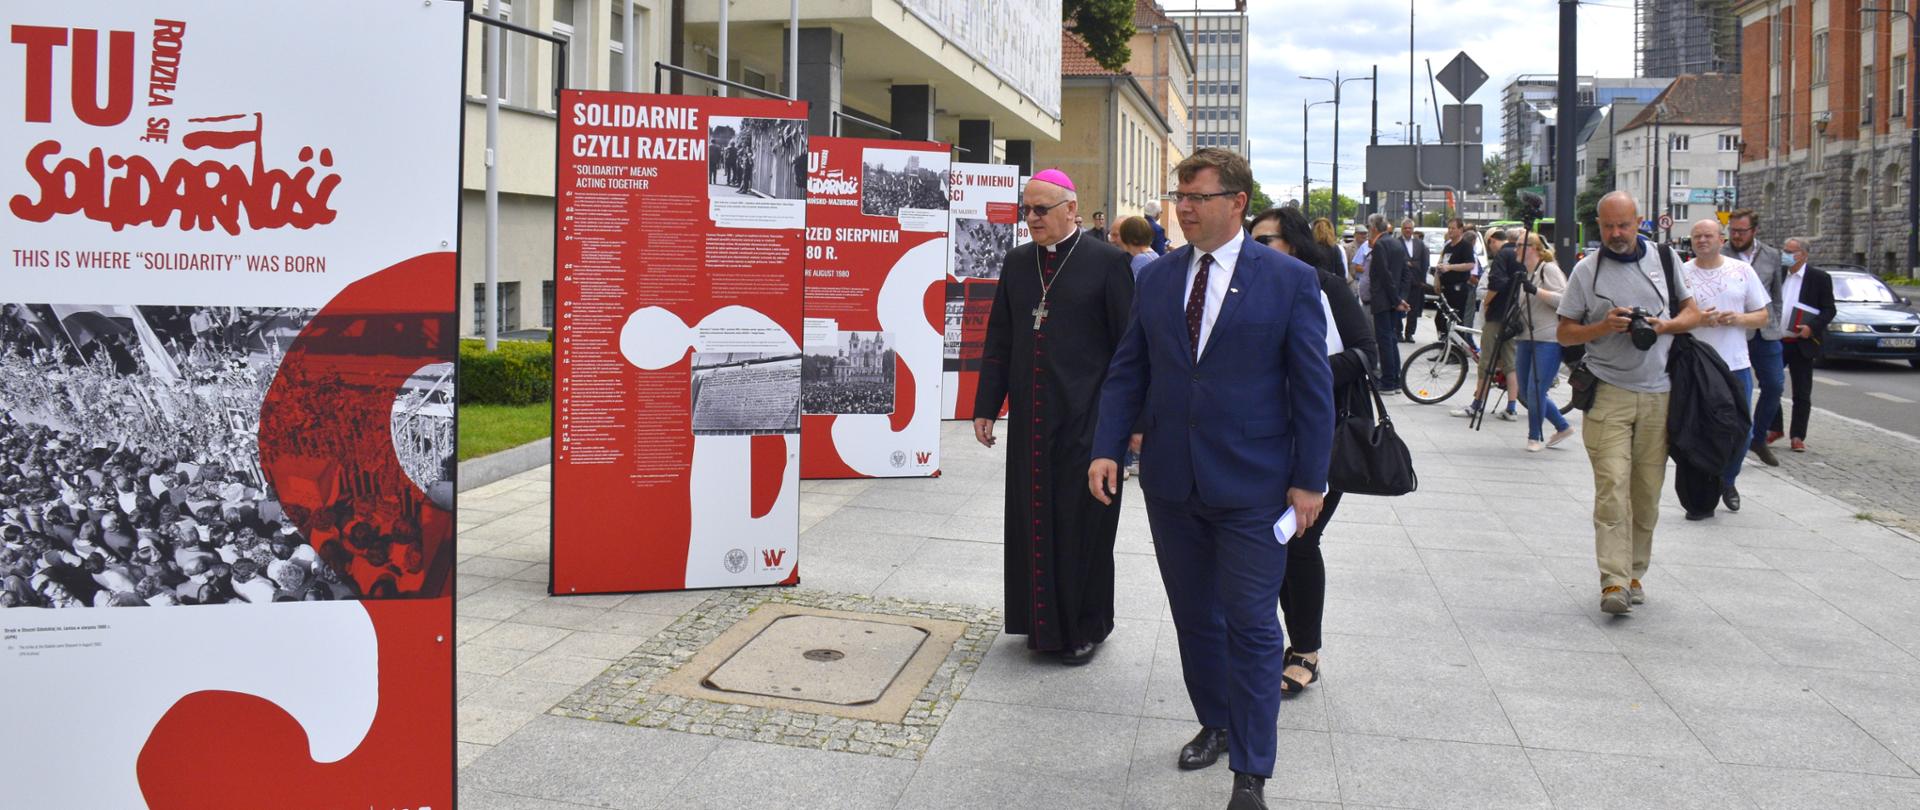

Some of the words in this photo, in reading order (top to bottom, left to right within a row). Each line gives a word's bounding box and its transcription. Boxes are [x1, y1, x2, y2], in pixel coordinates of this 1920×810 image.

[11, 24, 135, 127] TU
[573, 103, 699, 130] SOLIDARNIE
[140, 117, 170, 144] SIĘ
[572, 134, 629, 158] CZYLI
[637, 137, 706, 161] RAZEM
[629, 166, 658, 177] MEANS
[966, 174, 974, 186] W
[977, 175, 1014, 188] IMIENIU
[576, 177, 606, 189] ACTING
[608, 178, 649, 190] TOGETHER
[836, 228, 899, 243] SIERPNIEM
[13, 249, 49, 268] THIS
[55, 250, 70, 268] IS
[75, 251, 130, 270] WHERE
[246, 254, 280, 272] WAS
[285, 255, 326, 273] BORN
[826, 246, 838, 260] R.
